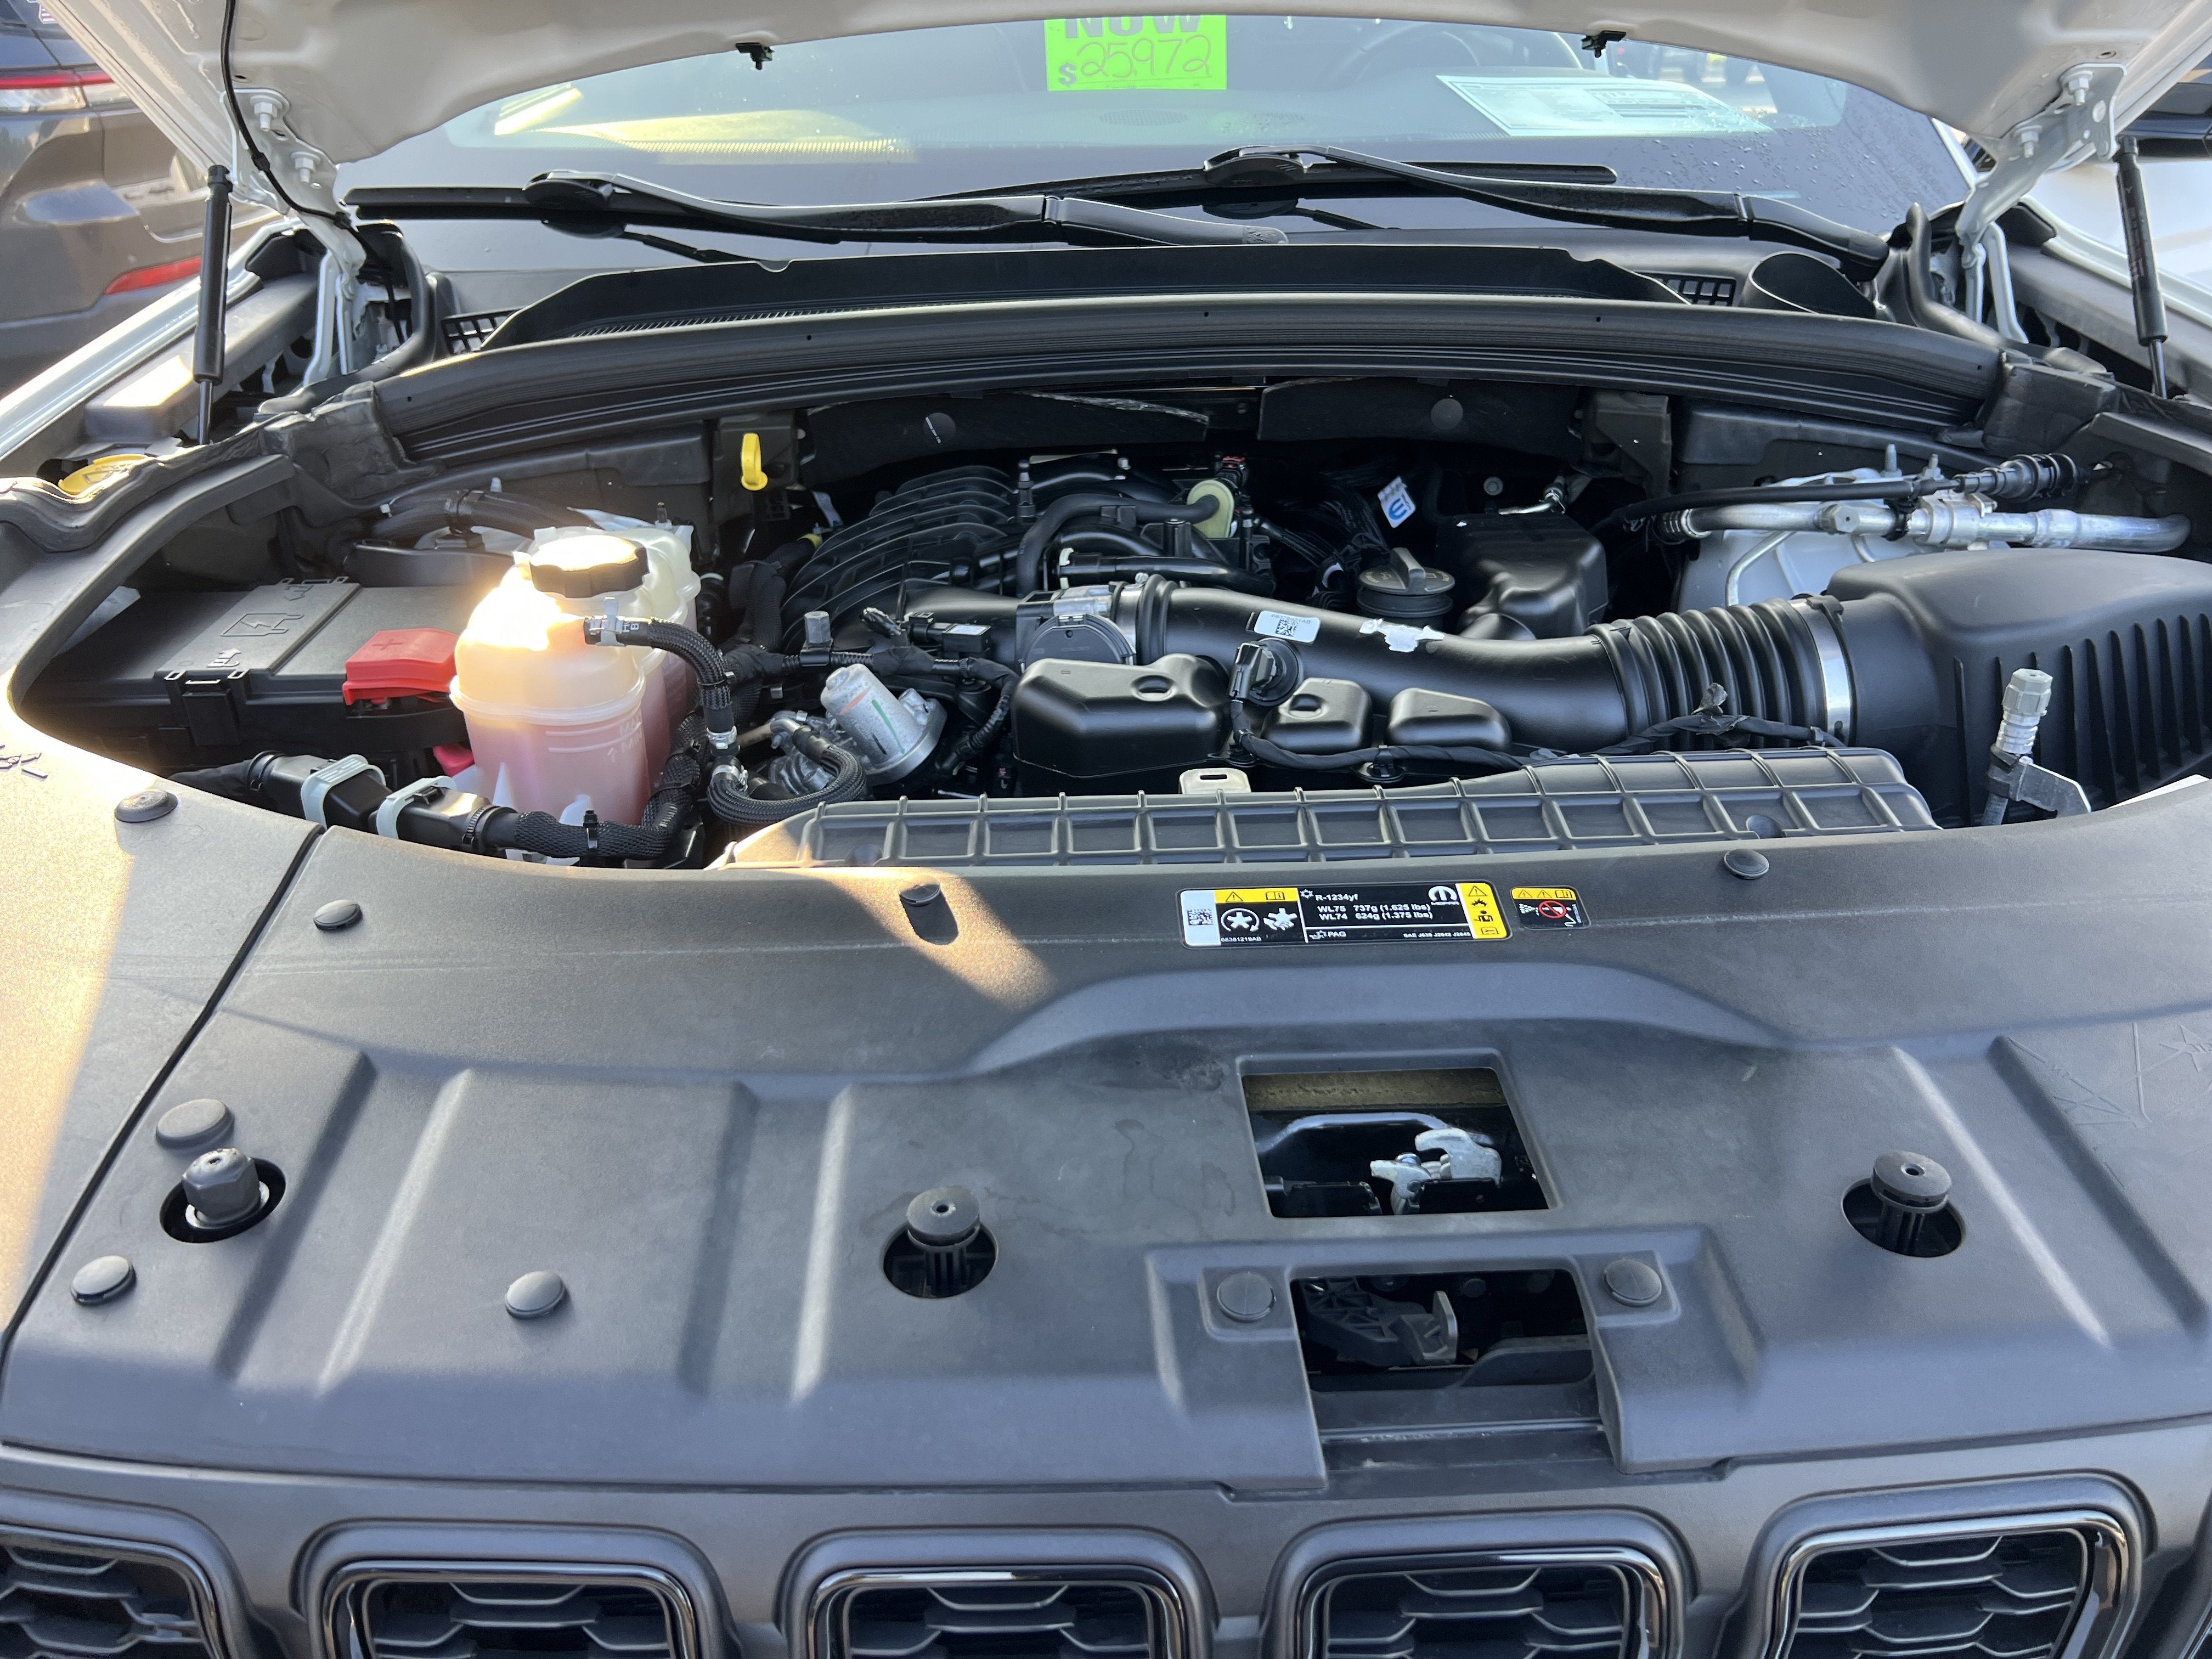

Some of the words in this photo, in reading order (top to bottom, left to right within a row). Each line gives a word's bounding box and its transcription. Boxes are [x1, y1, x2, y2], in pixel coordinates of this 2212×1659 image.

[1315, 893, 1358, 901] R-1234yf
[1353, 905, 1378, 913] 737g
[1380, 904, 1410, 912] (1.625
[1355, 912, 1380, 921] 624g
[1381, 912, 1412, 920] (1.375
[1413, 911, 1433, 919] lbs)
